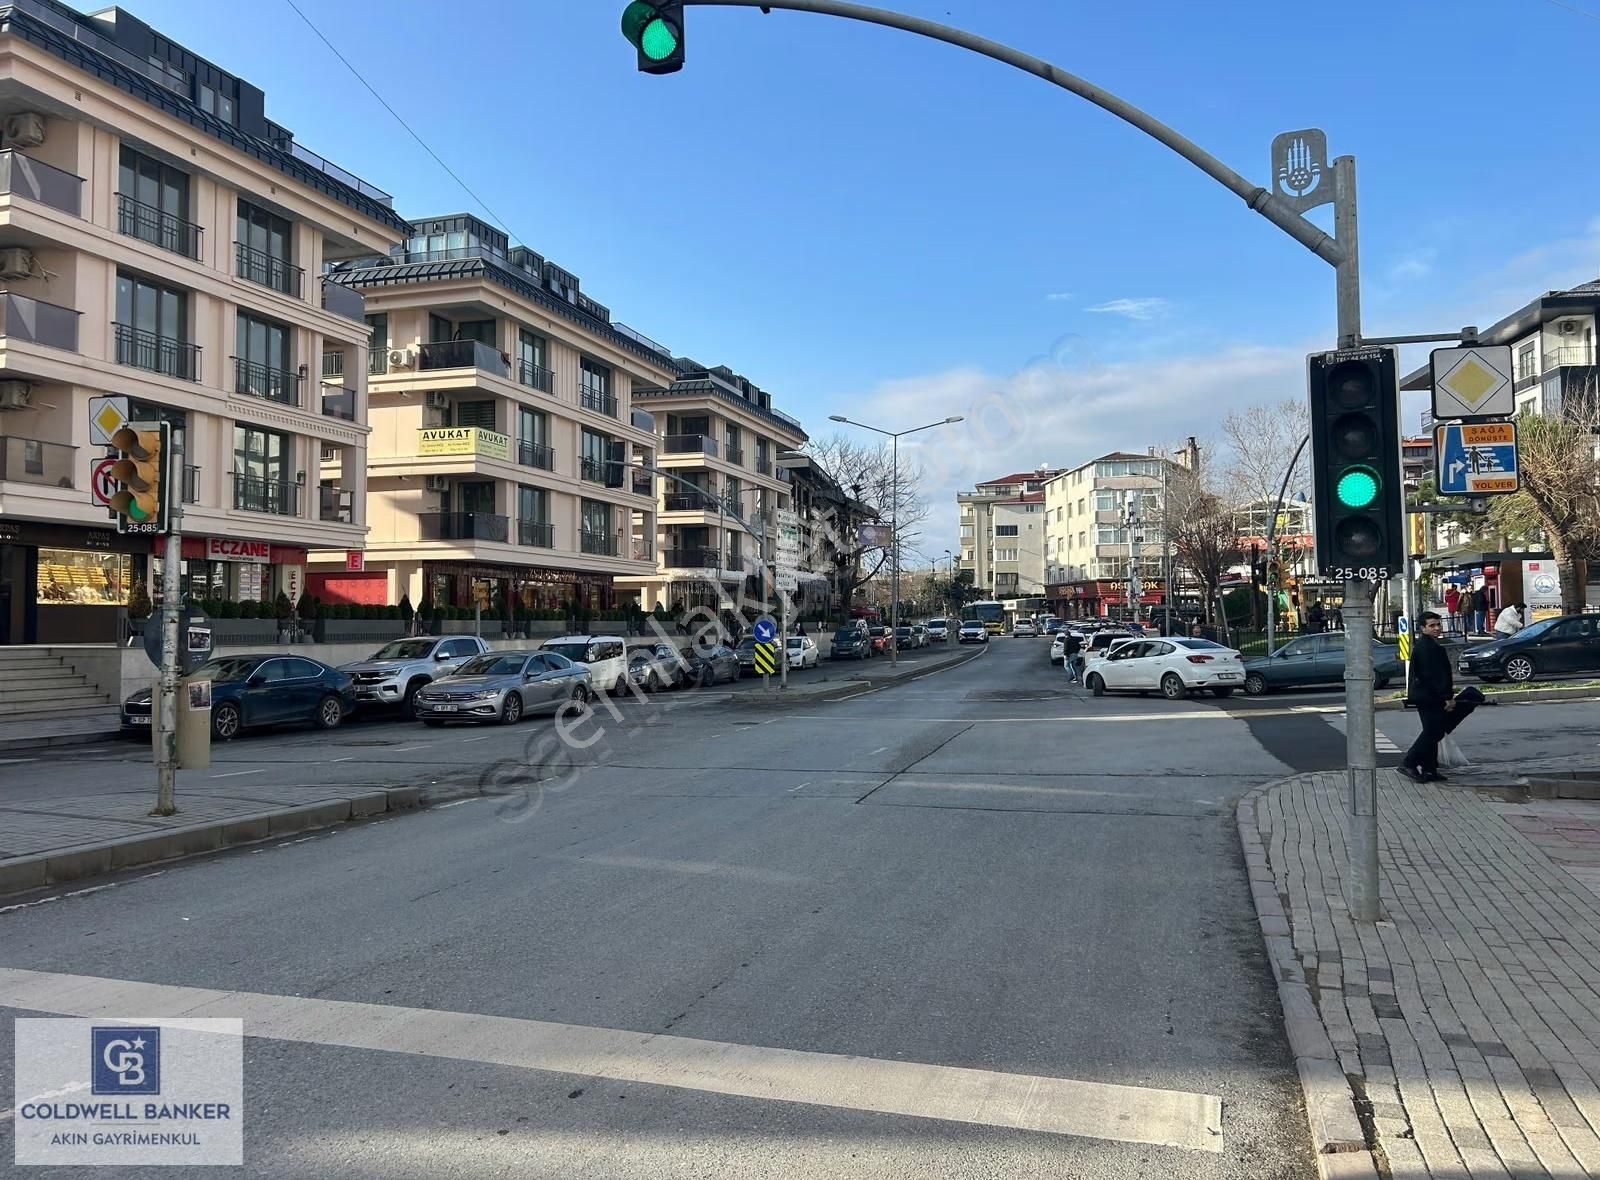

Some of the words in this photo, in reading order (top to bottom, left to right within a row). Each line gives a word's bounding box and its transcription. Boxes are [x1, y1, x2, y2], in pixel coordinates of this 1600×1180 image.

[422, 429, 470, 440] AVUKAT
[1471, 426, 1505, 434] SAĞA
[478, 430, 508, 447] AVUKAT
[128, 523, 157, 533] 25-085
[211, 538, 269, 557] ECZANE
[350, 554, 360, 569] E
[1335, 566, 1388, 581] 25-085
